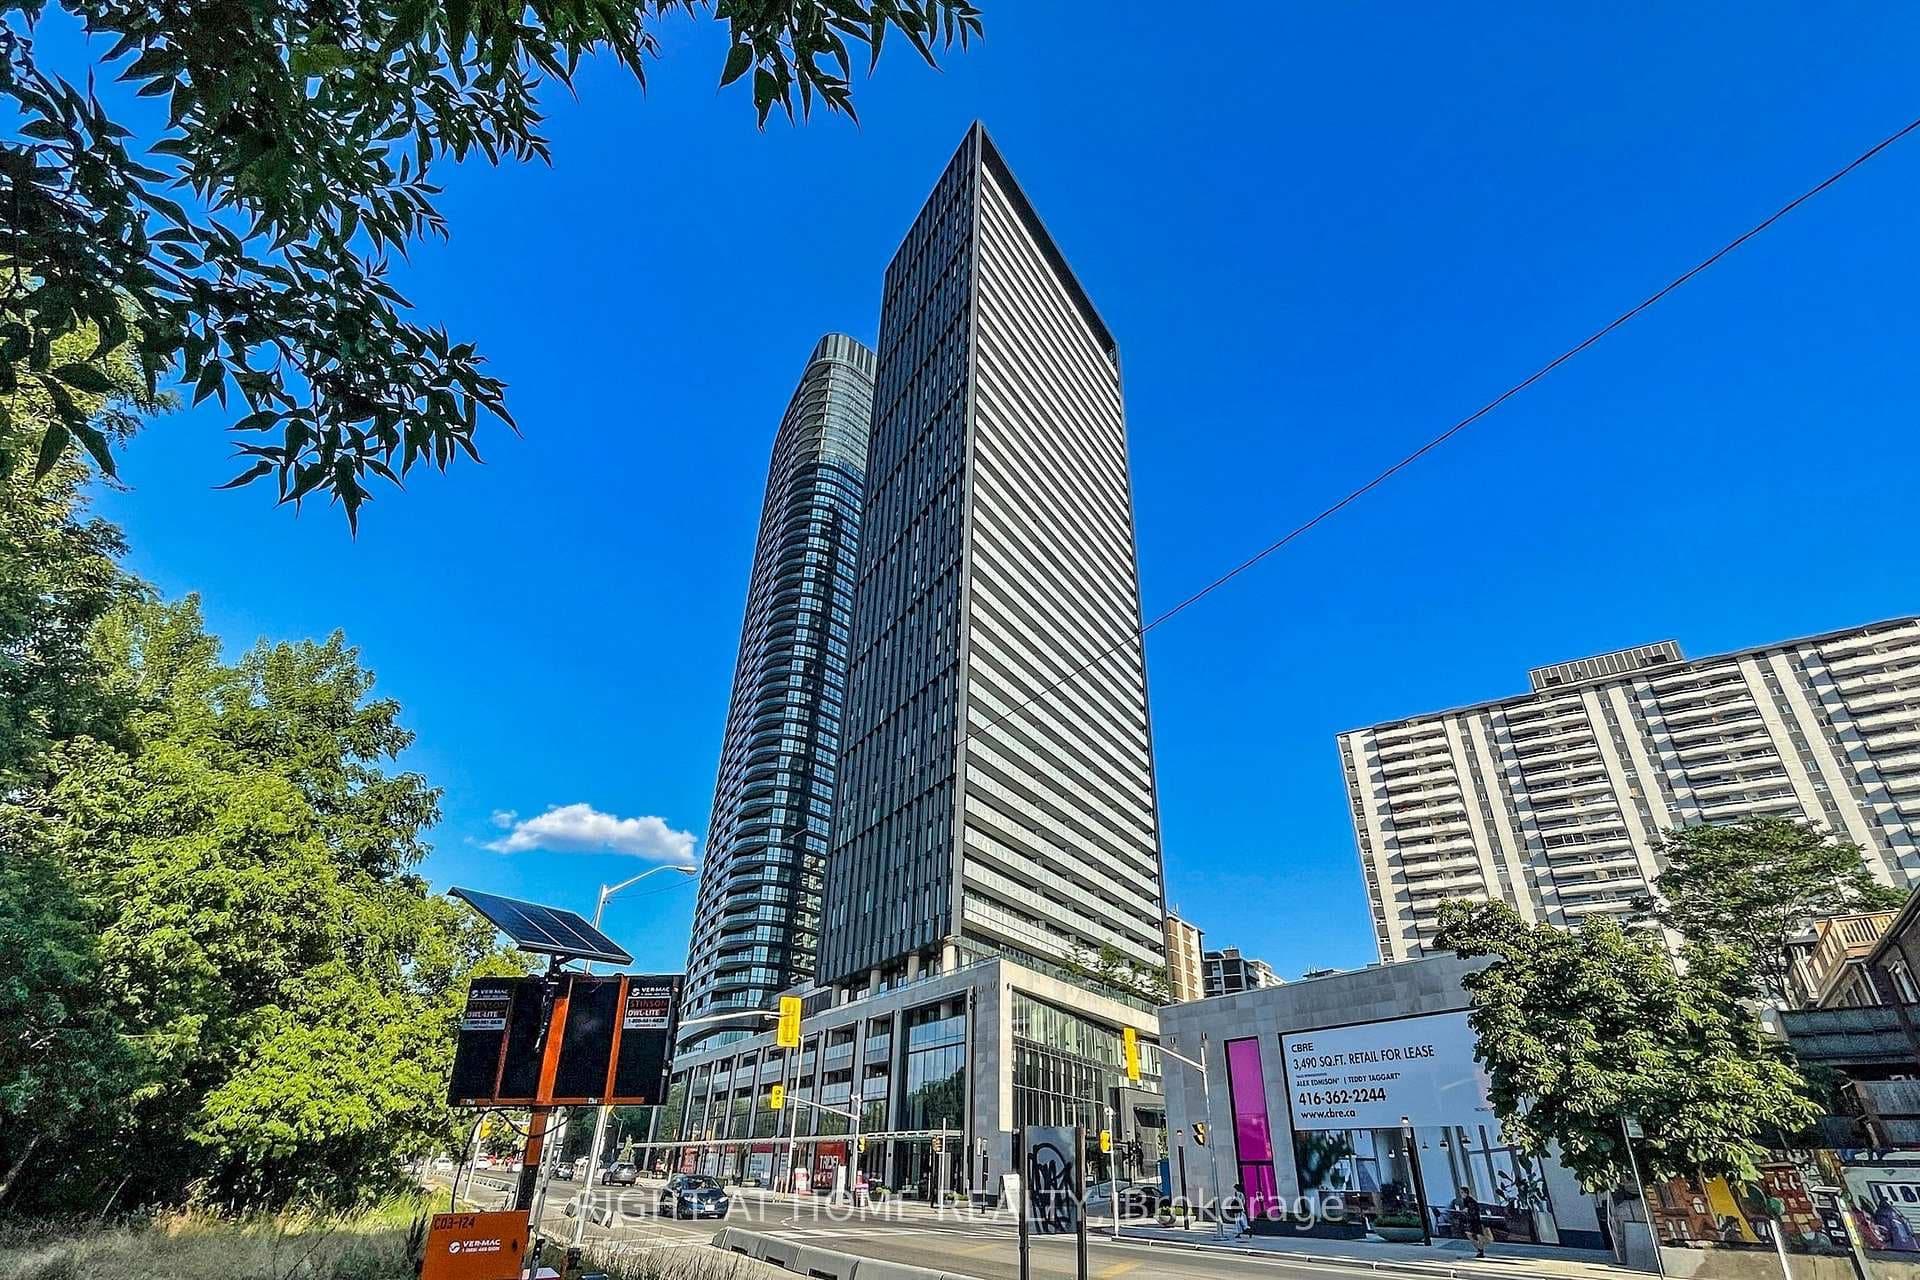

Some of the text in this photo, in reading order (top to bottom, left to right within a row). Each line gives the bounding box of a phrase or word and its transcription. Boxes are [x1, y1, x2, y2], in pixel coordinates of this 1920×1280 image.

[1291, 1042, 1314, 1053] CBRE
[1293, 1056, 1317, 1071] 3,490
[1348, 1051, 1379, 1065] RETAIL
[1381, 1048, 1402, 1061] FOR
[1403, 1045, 1435, 1059] LEASE
[1296, 1079, 1310, 1087] ALEX
[1348, 1075, 1367, 1084] TEDDY
[1299, 1087, 1387, 1105] 416-362-2244
[1301, 1108, 1356, 1119] www.cbre.ca
[462, 1239, 501, 1248] VER-MAC
